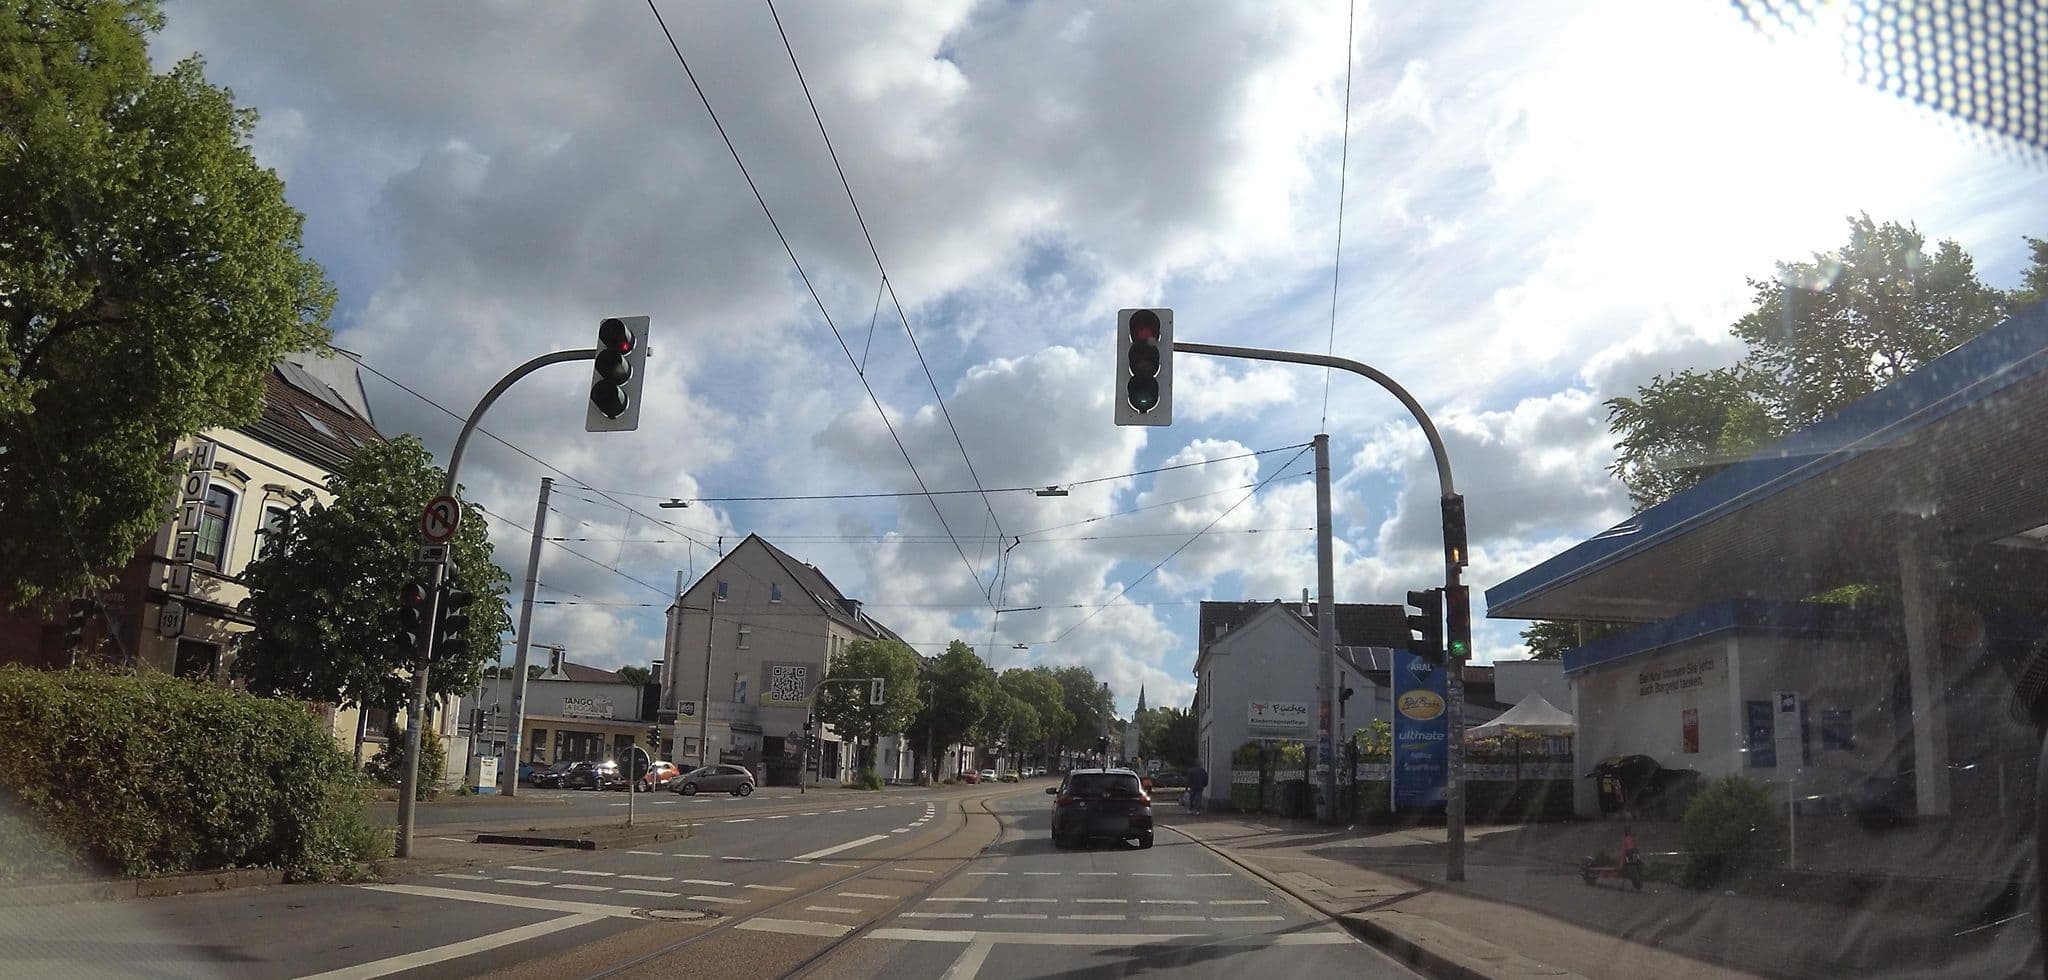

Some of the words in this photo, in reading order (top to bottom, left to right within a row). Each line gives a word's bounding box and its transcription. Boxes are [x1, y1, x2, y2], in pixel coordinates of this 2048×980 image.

[173, 446, 208, 590] HOTEL
[162, 614, 179, 628] 191
[1410, 663, 1432, 672] ARAL
[564, 697, 594, 705] TANGO
[1399, 730, 1445, 741] ultimate
